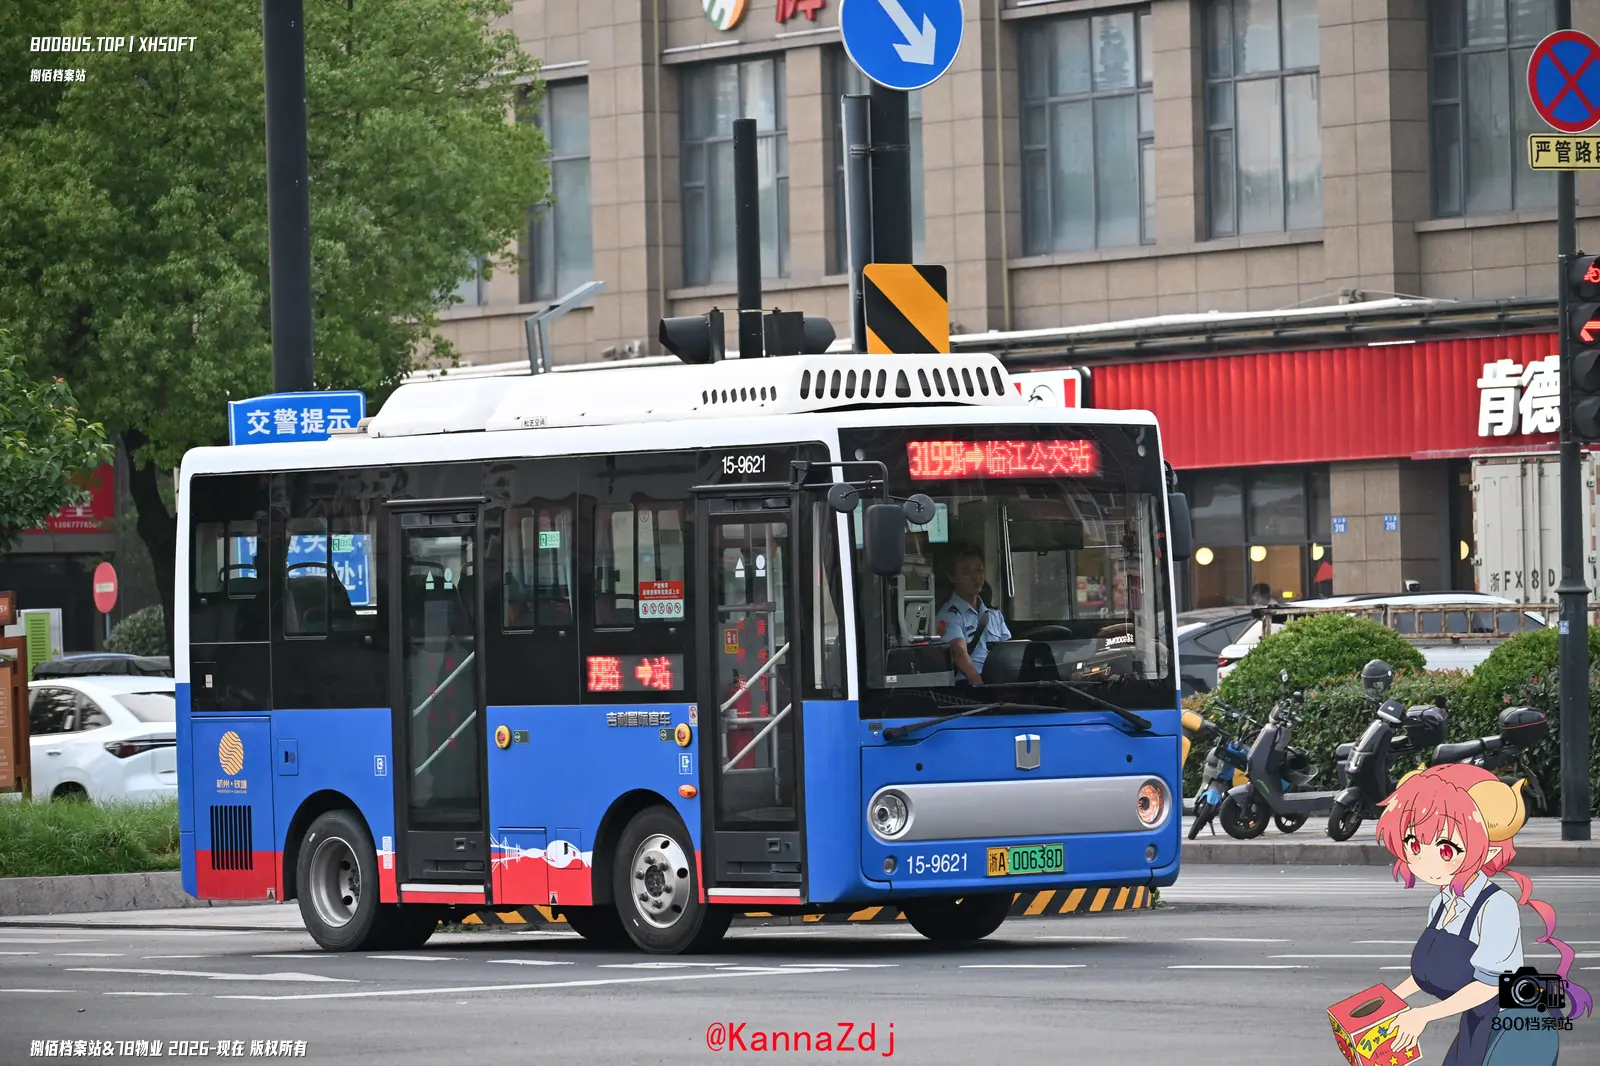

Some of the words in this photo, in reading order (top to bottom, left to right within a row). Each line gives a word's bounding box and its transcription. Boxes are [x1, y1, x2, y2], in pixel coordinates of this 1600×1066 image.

[1535, 140, 1600, 163] 严管路
[246, 408, 351, 435] 交警提示
[721, 455, 766, 474] 15-9621
[986, 440, 1091, 475] 临江公交站
[907, 853, 968, 874] 15-9621
